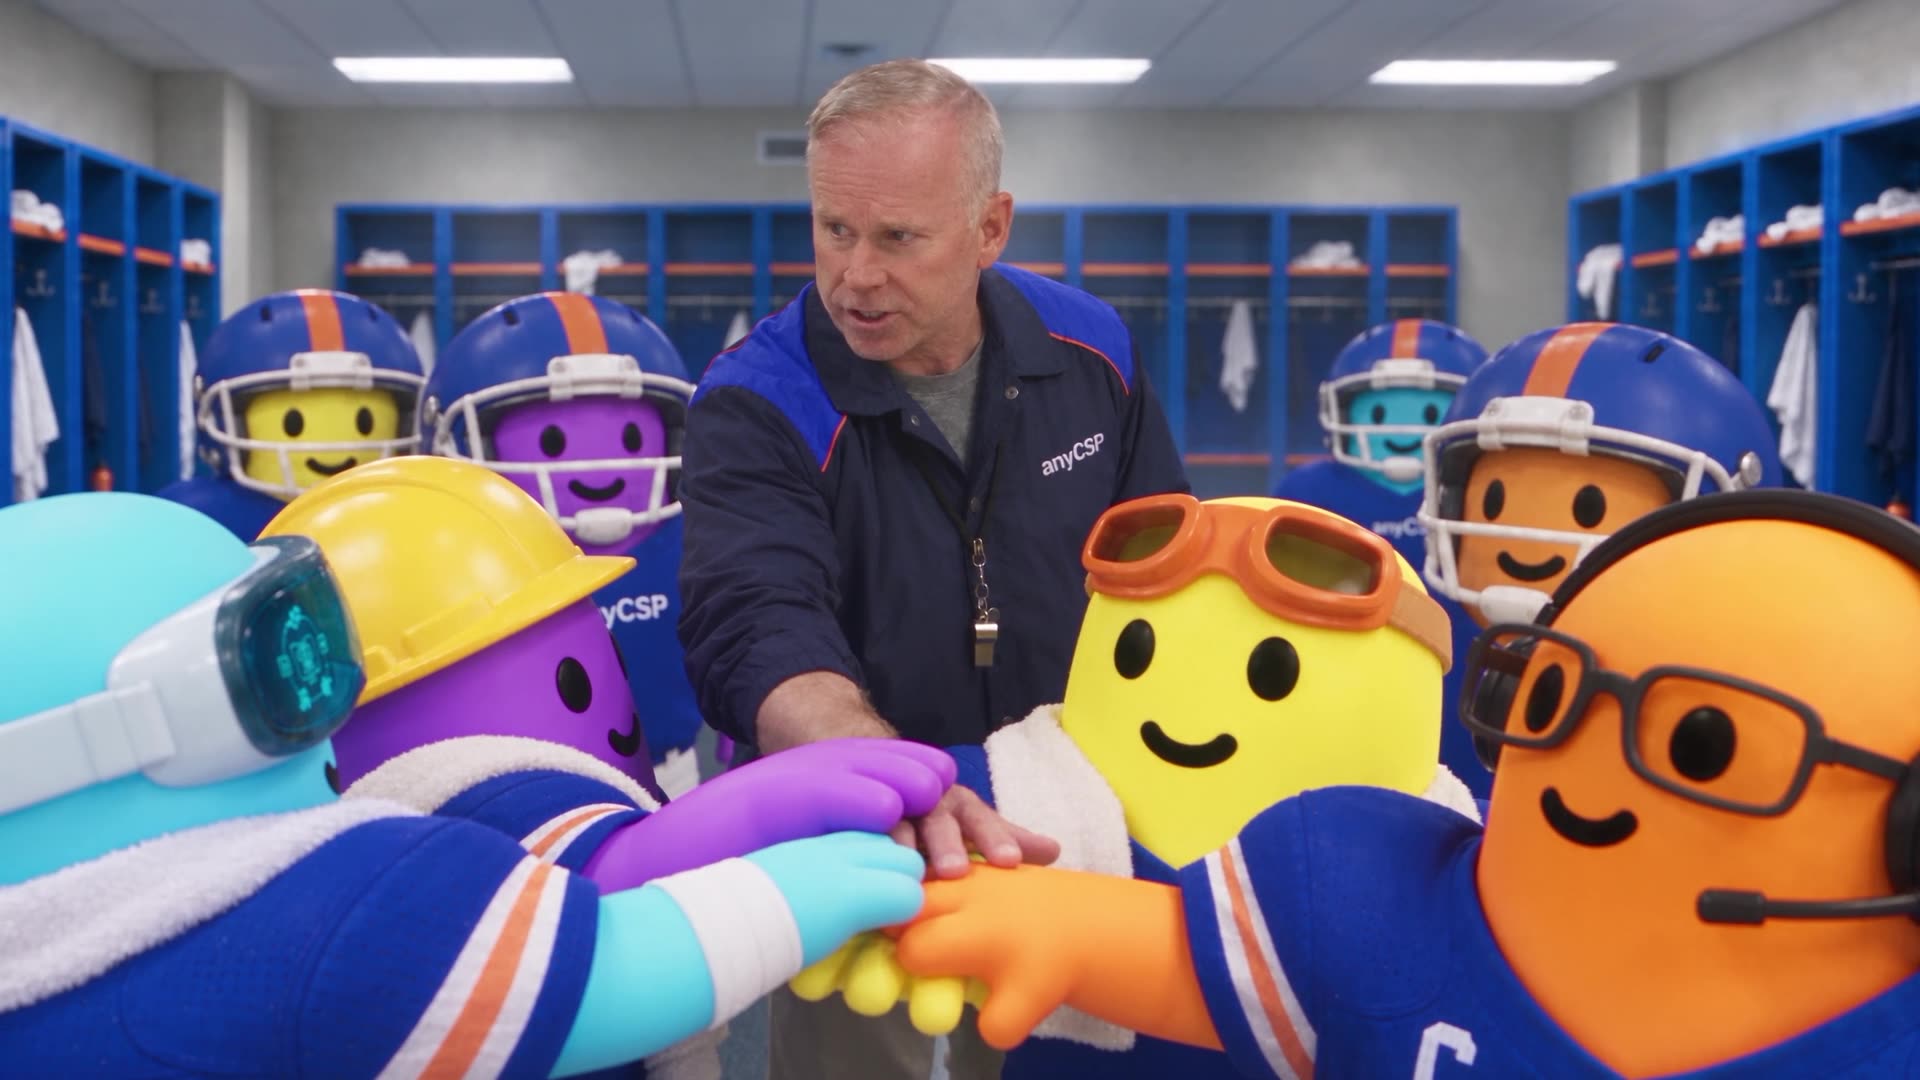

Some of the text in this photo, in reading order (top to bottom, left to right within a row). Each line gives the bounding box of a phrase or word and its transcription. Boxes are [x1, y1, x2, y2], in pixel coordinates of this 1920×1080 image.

[1041, 432, 1105, 476] anyCSP
[1371, 516, 1428, 539] anyC
[600, 593, 669, 631] yCSP
